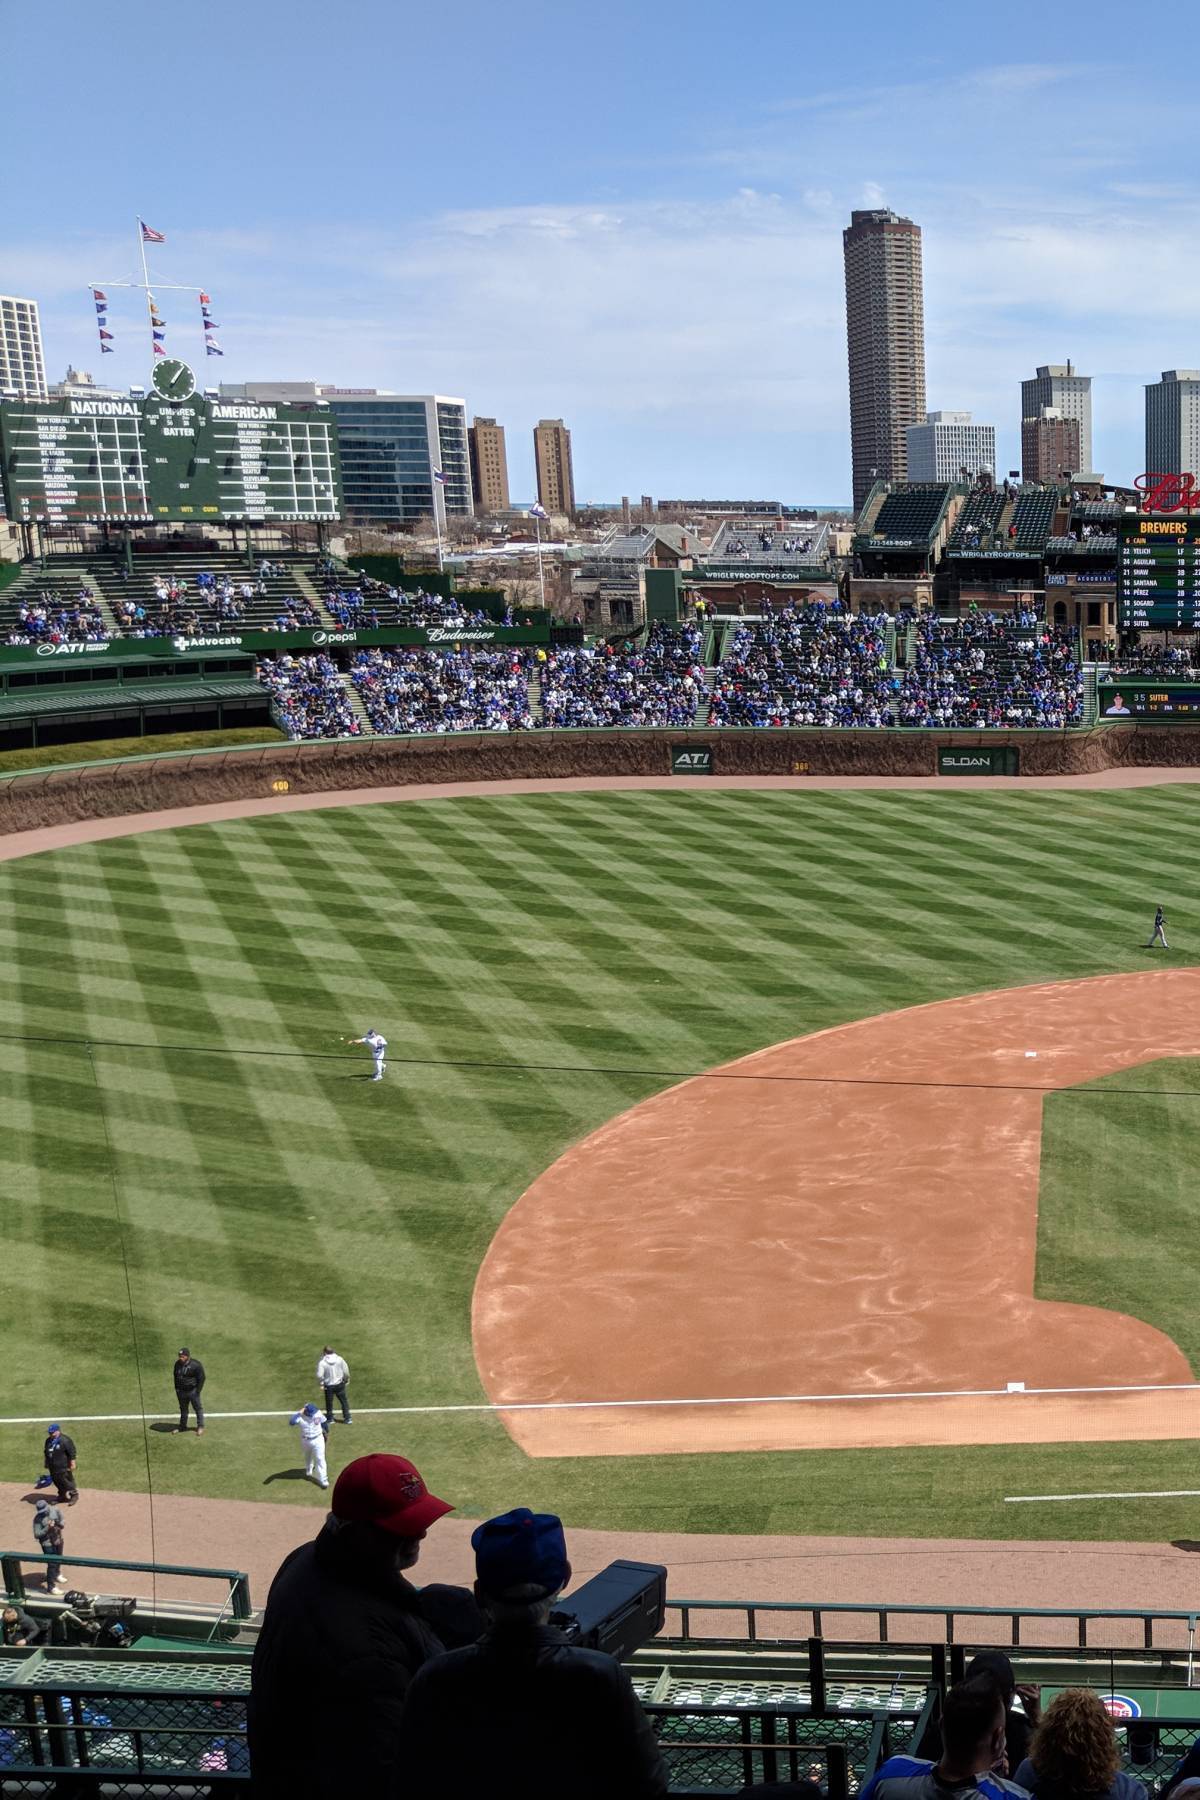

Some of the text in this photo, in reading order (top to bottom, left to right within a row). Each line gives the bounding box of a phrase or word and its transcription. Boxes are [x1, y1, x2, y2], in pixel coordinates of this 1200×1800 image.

[71, 401, 142, 415] NATIONAL
[159, 408, 196, 416] UMPIRES
[212, 406, 277, 419] AMERICAN
[163, 428, 195, 436] BATTER
[1140, 522, 1188, 533] BREWERS
[705, 572, 800, 580] WRIGLEYROOFTOPS.COM
[328, 631, 357, 643] pepsi
[426, 628, 495, 642] Budweiser
[190, 635, 242, 647] Advocate
[55, 643, 84, 654] ATI
[675, 753, 709, 764] ATI
[942, 757, 990, 766] SLOAN
[272, 781, 289, 791] 400
